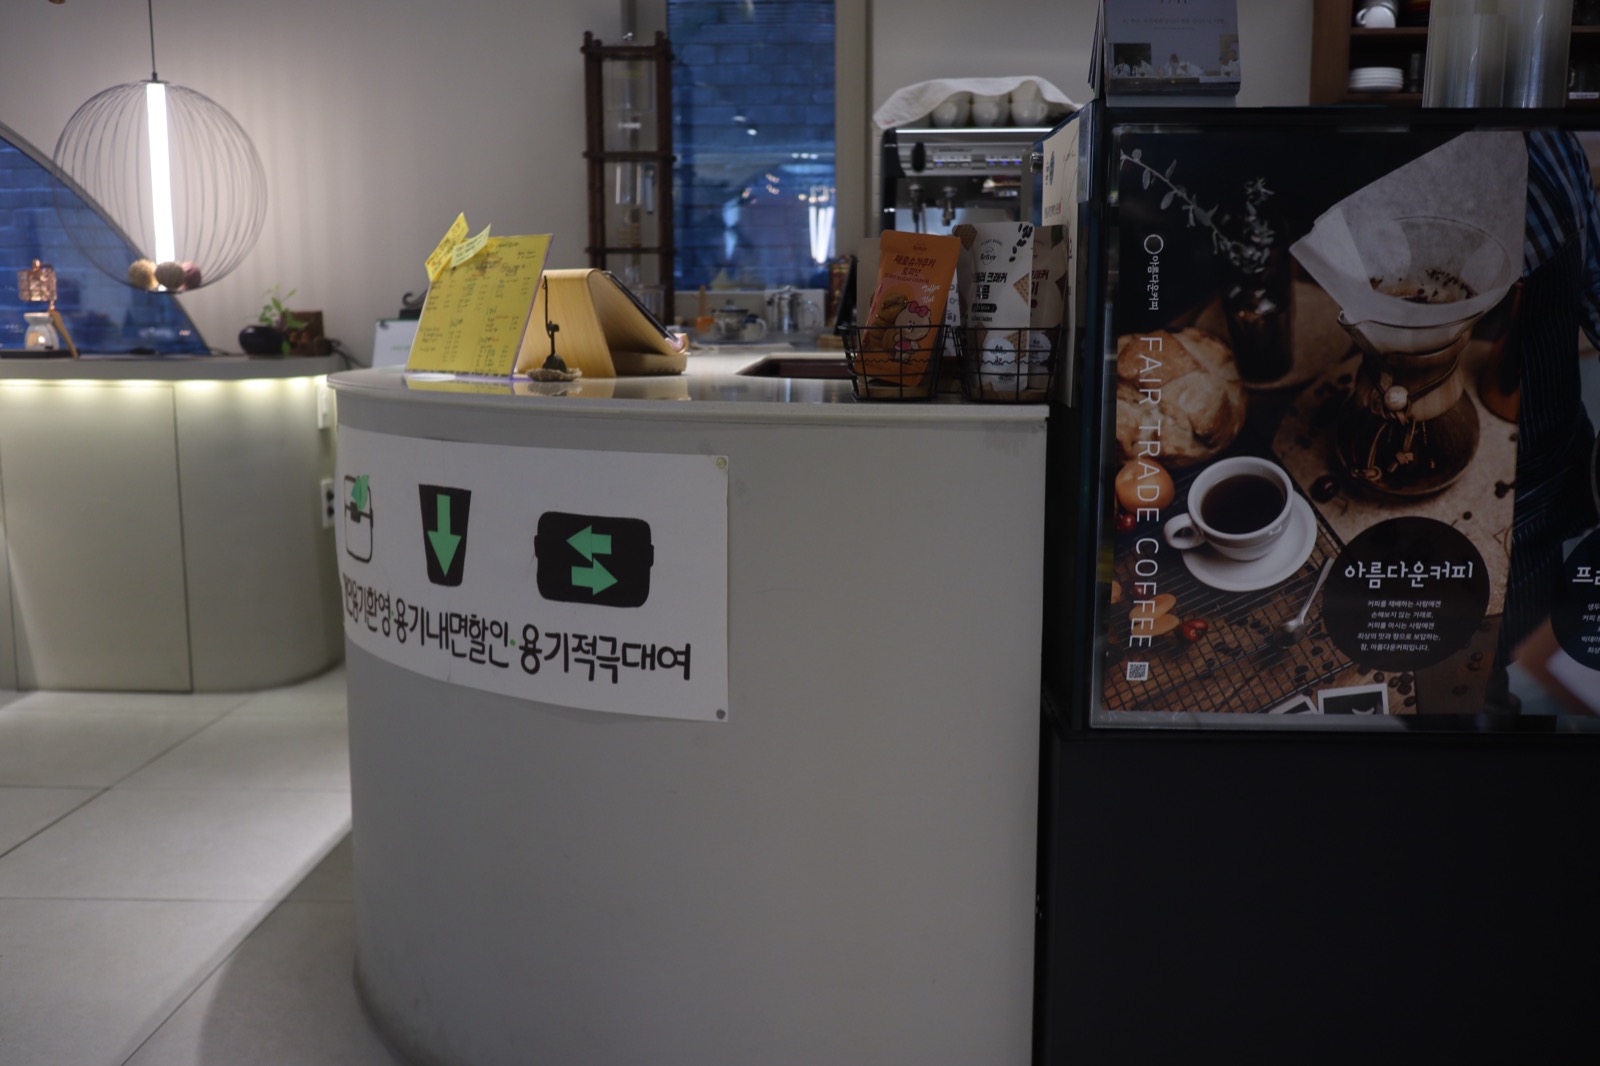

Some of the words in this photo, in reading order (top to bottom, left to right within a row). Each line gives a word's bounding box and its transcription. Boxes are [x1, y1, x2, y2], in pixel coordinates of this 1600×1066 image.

[894, 254, 937, 268] 제로슈가쿠키
[1147, 255, 1160, 310] 아름다운커피
[1139, 337, 1163, 404] FAIR
[1137, 420, 1161, 522] TRADE
[1344, 561, 1474, 589] 아름다운커피
[1129, 538, 1159, 647] COFFEE
[1368, 600, 1387, 608] 커피를
[1388, 600, 1414, 608] 재배하는
[1415, 600, 1441, 608] 사람에겐
[1371, 611, 1397, 619] 손해보지
[1398, 611, 1411, 619] 않는
[1357, 632, 1377, 640] 최상의
[1378, 632, 1391, 640] 맛과
[1393, 632, 1412, 640] 향으로
[1368, 622, 1387, 630] 커피를
[1388, 622, 1407, 630] 마시는
[1409, 622, 1435, 630] 사람에겐
